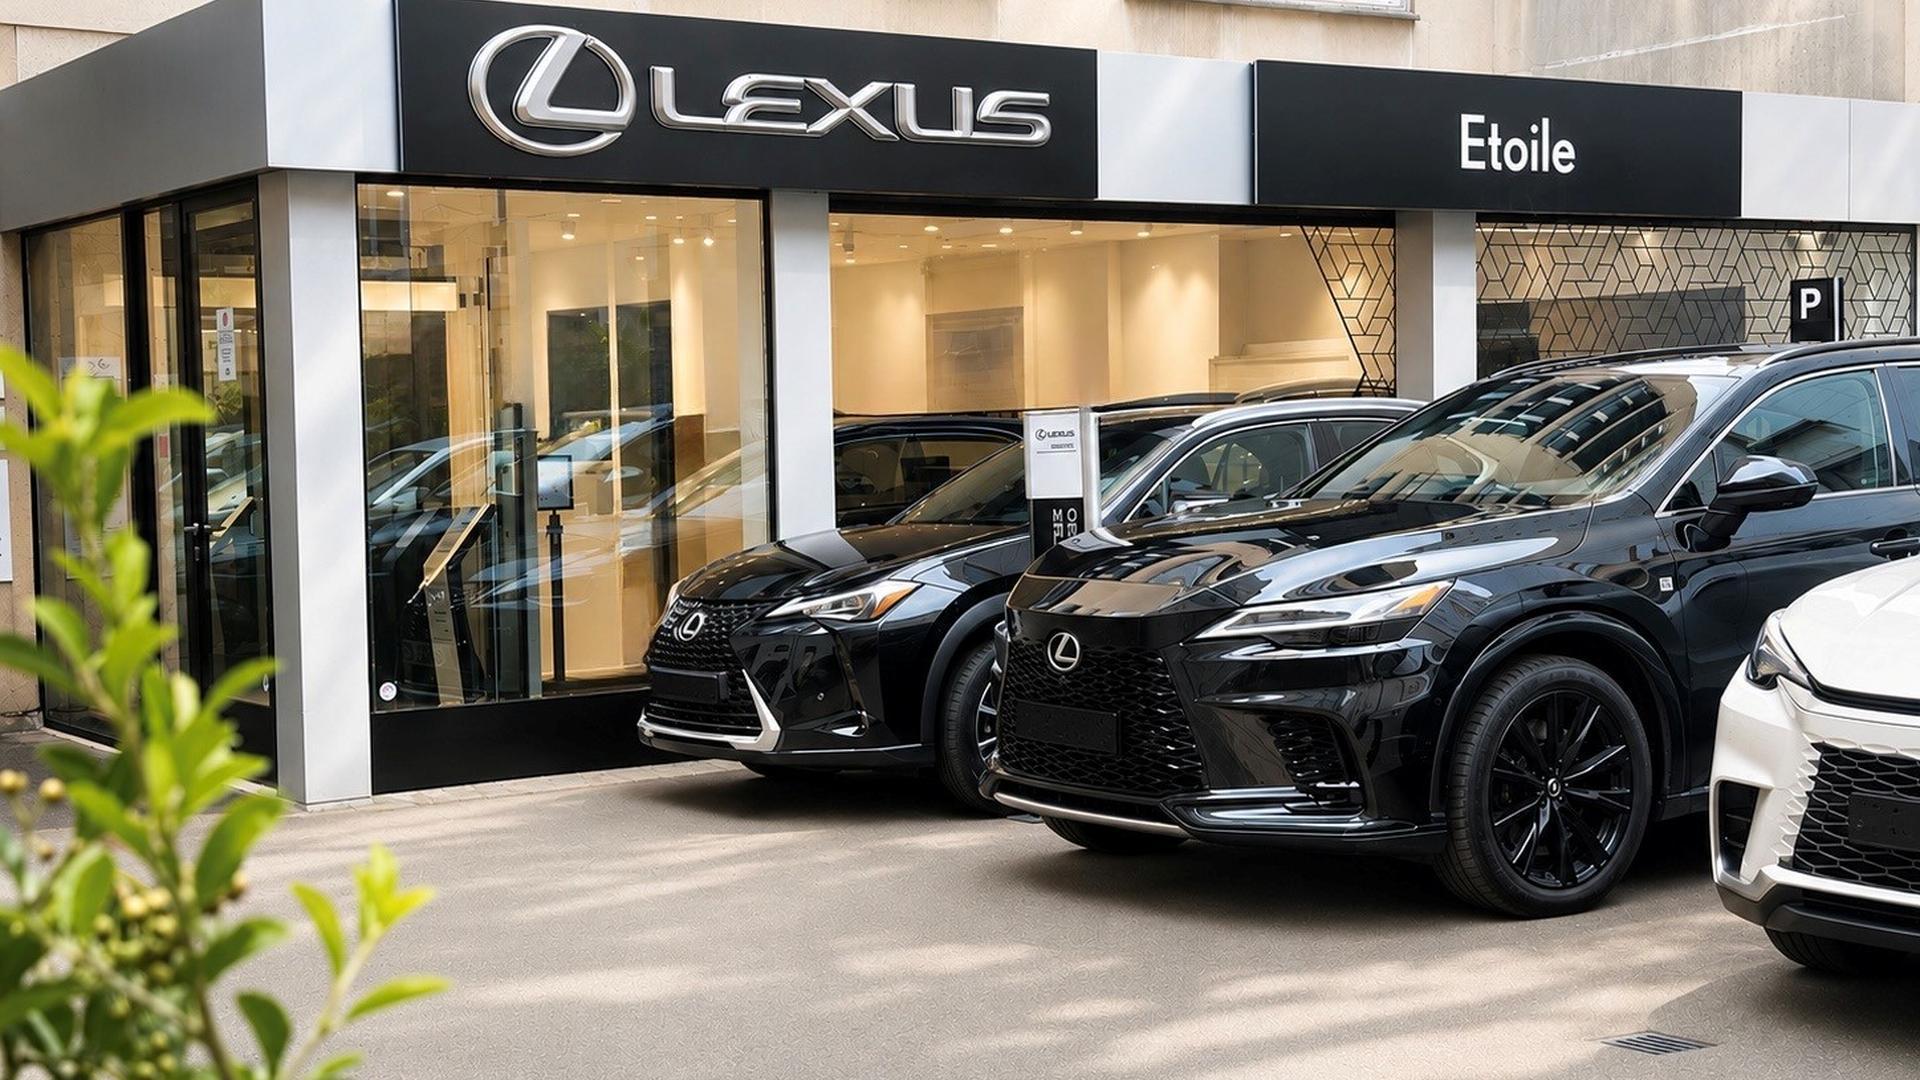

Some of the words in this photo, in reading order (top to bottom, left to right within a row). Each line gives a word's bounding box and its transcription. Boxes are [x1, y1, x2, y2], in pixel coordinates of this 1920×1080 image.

[650, 65, 1052, 148] LEXUS
[1460, 113, 1576, 174] Etoile
[1800, 287, 1822, 319] P
